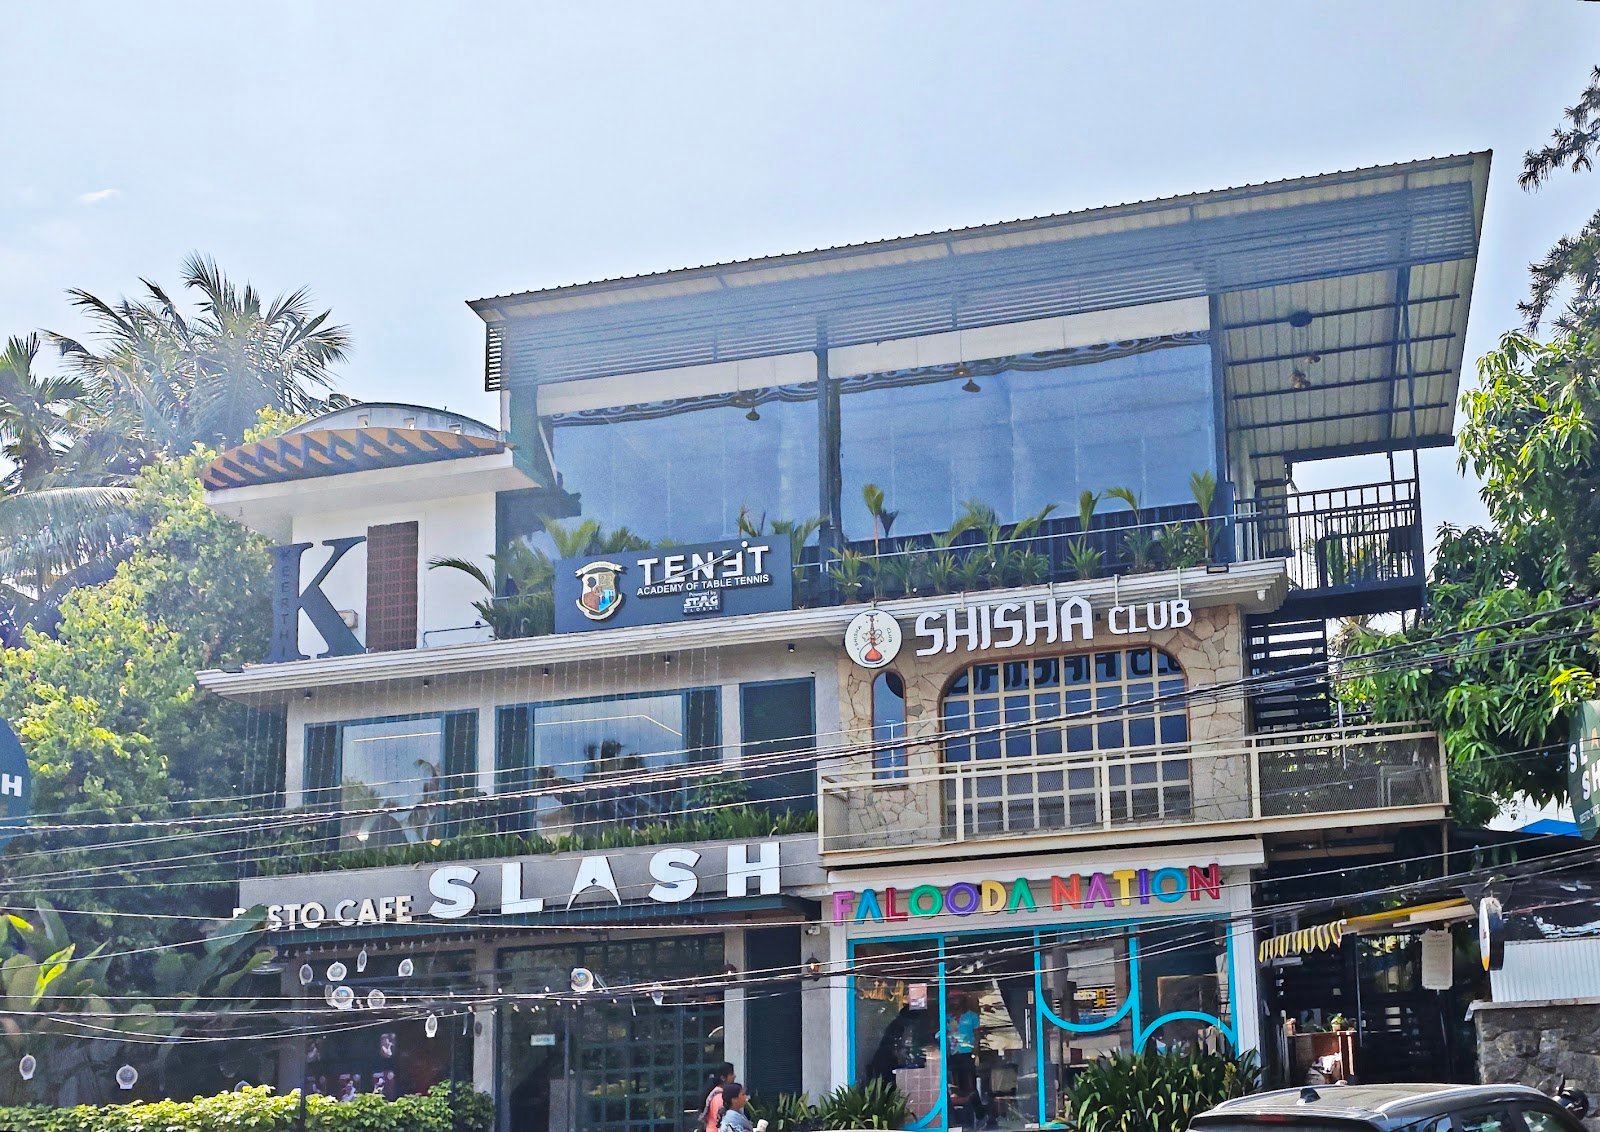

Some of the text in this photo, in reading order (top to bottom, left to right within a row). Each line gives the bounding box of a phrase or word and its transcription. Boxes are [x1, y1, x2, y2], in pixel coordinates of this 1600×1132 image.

[637, 574, 769, 596] ACADEMY OF TABLE TENNIS
[683, 595, 718, 608] STAG
[914, 596, 1192, 656] SHISHA CLUB
[428, 842, 780, 919] SLASH
[832, 863, 1221, 926] FALOODA NATION
[335, 895, 413, 926] CAFE
